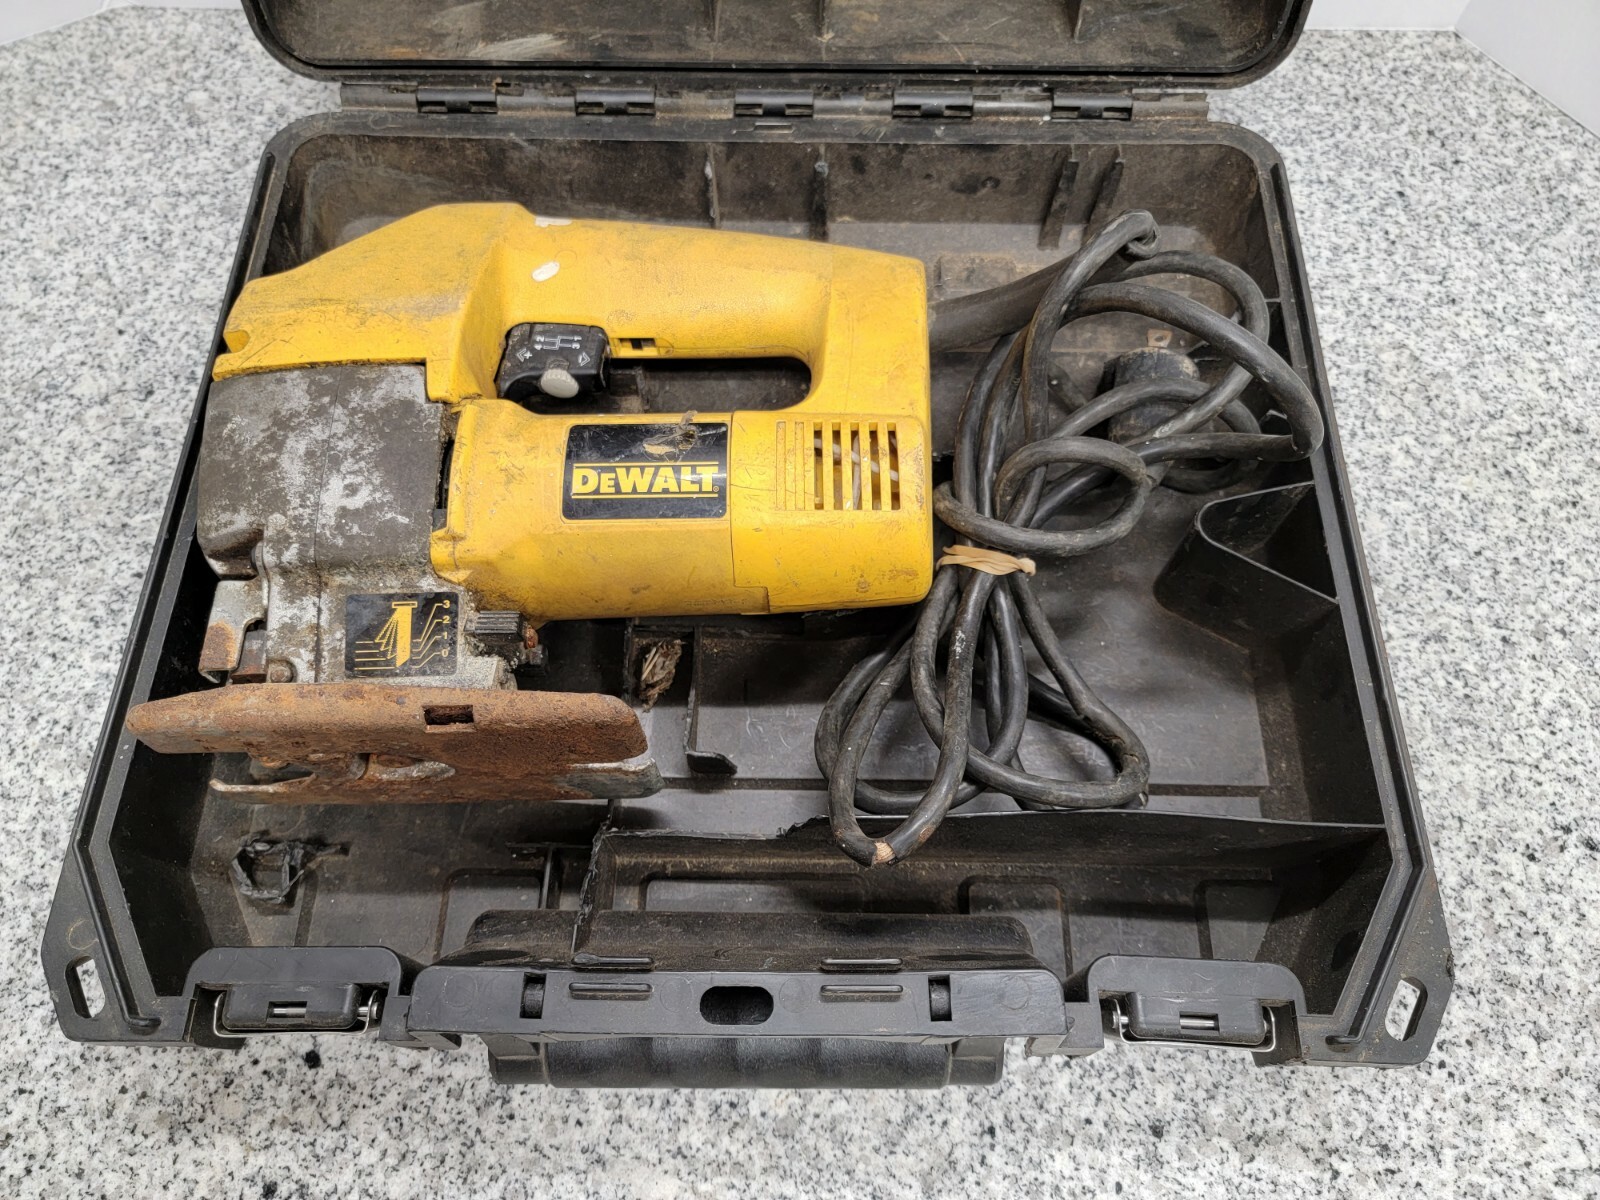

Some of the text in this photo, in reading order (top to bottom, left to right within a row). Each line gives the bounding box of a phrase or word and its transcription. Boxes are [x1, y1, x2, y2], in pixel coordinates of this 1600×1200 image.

[442, 600, 450, 608] 3
[442, 615, 450, 623] 2
[441, 648, 449, 657] 0
